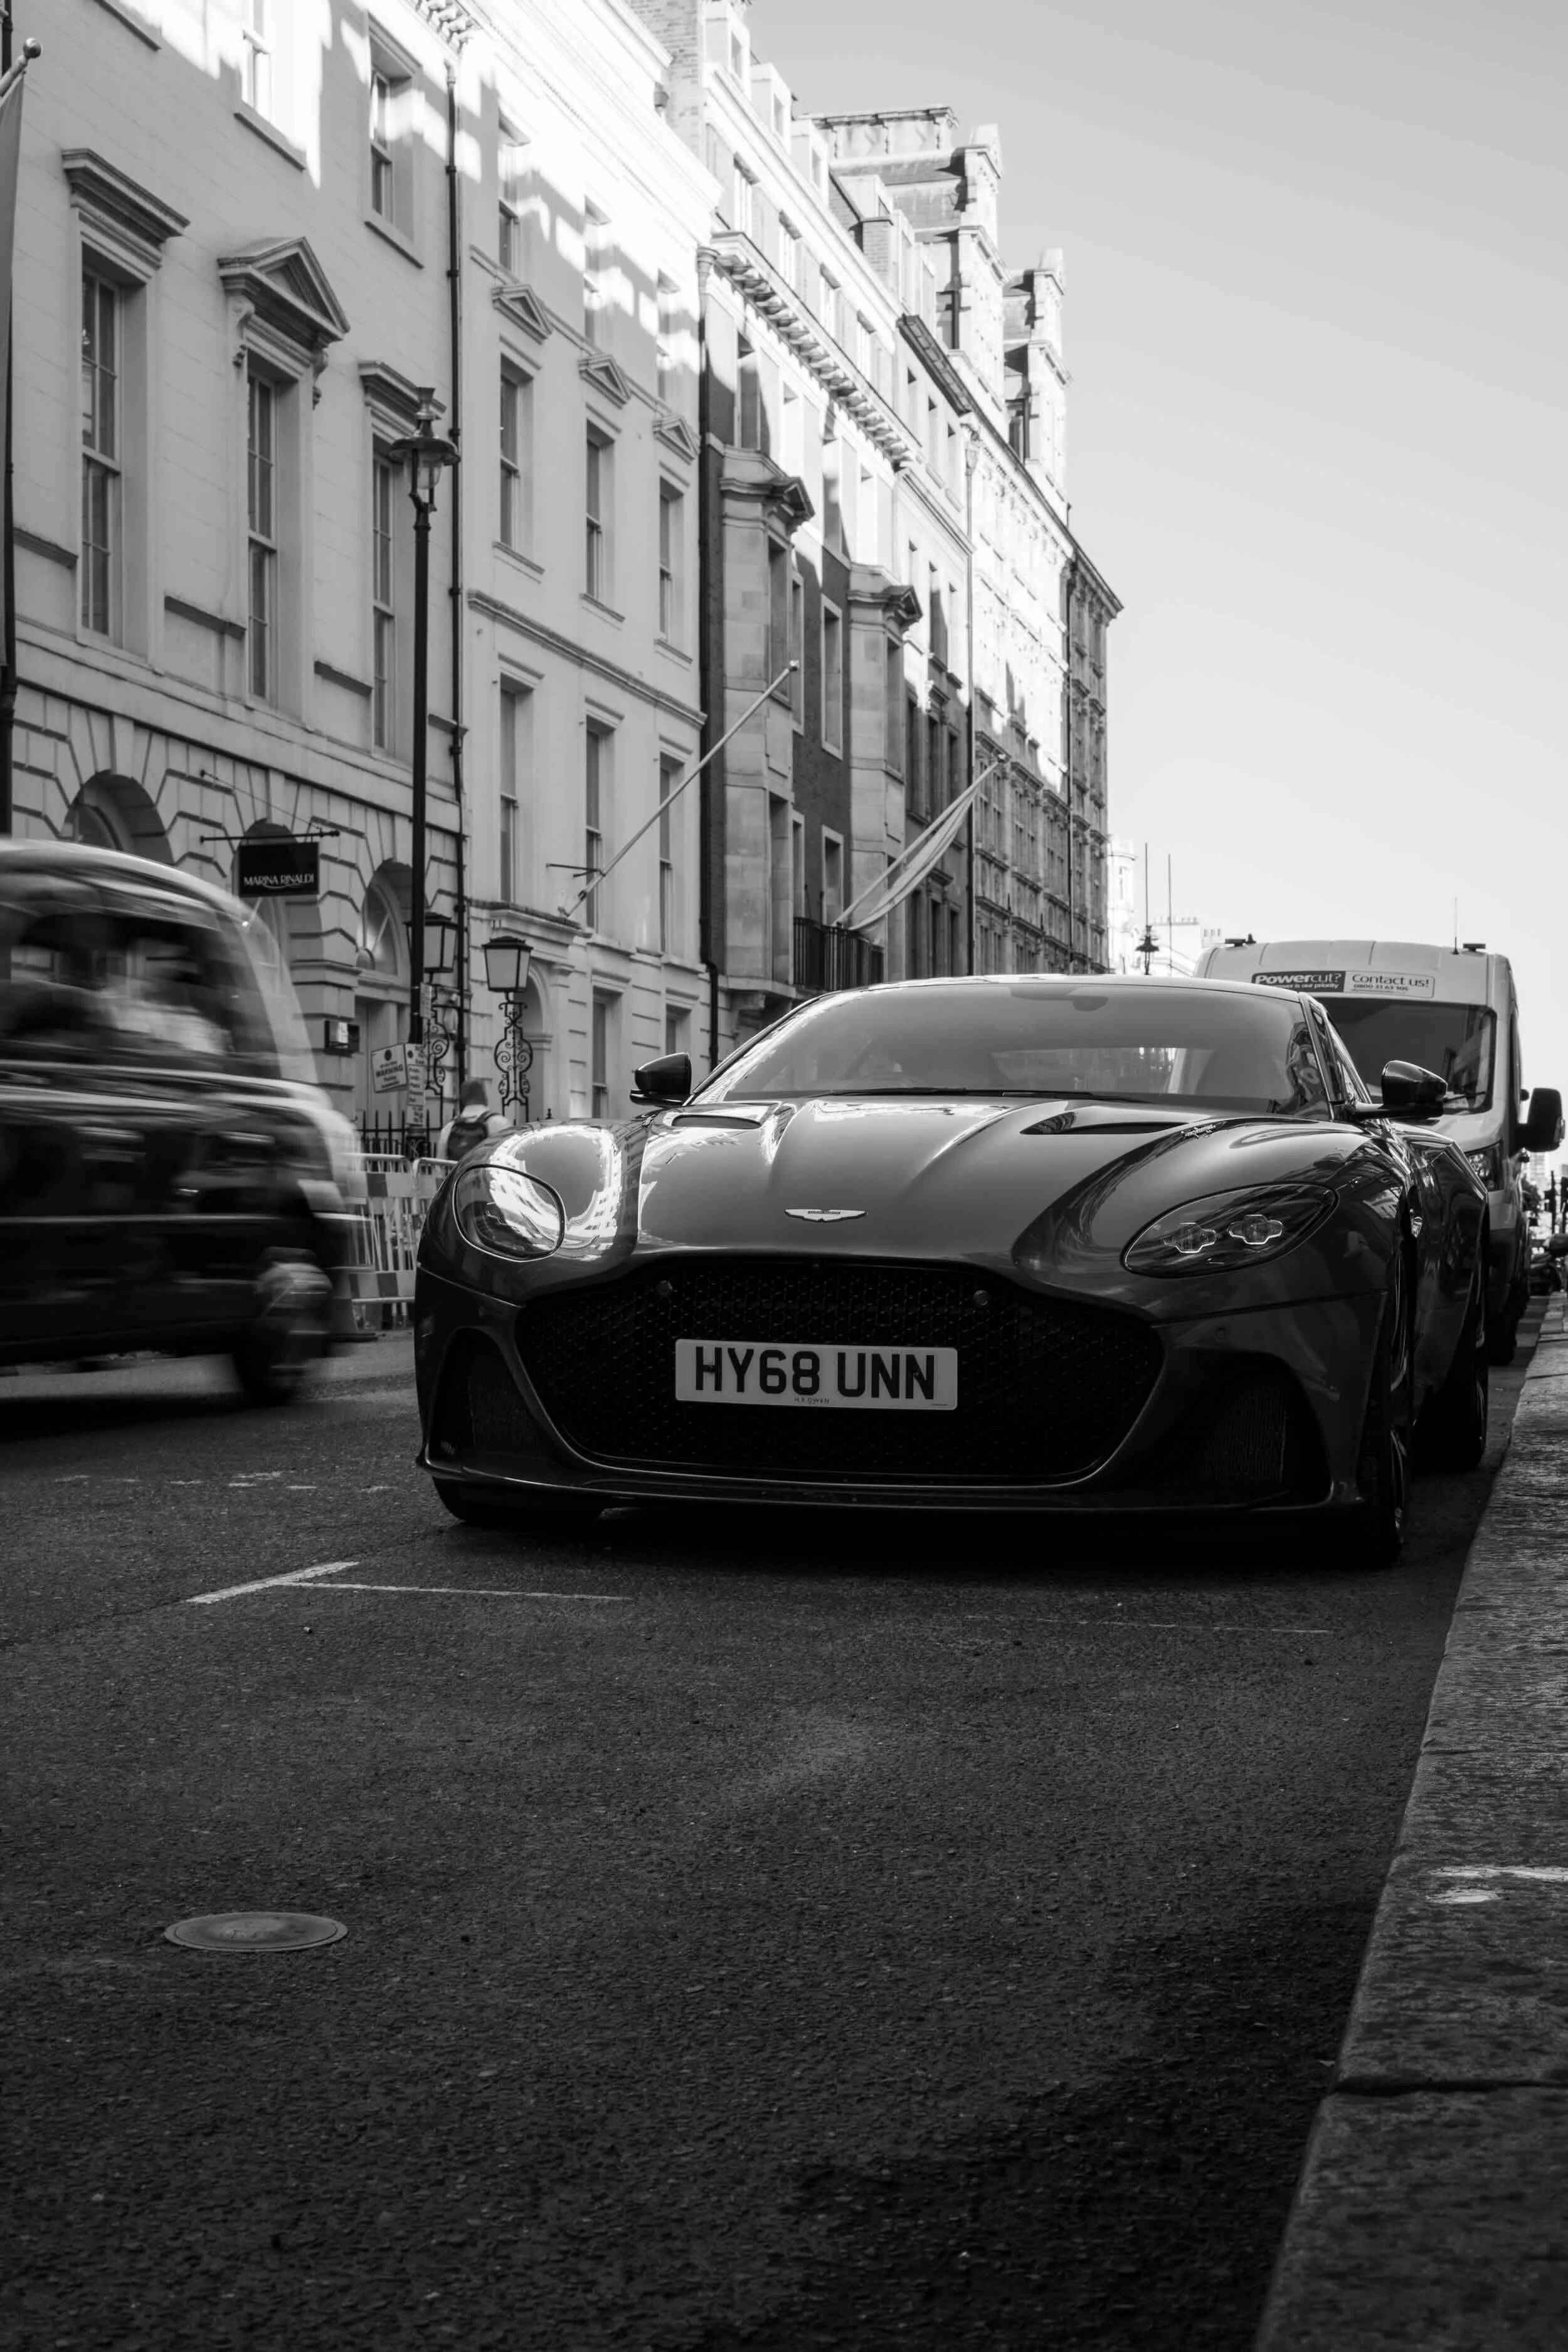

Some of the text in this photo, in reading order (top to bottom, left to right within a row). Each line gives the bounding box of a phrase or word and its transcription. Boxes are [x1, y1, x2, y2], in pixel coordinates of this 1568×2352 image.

[243, 873, 314, 886] MARINA RINALDI
[1352, 974, 1429, 987] Contact us!
[696, 1346, 935, 1400] HY68 UNN
